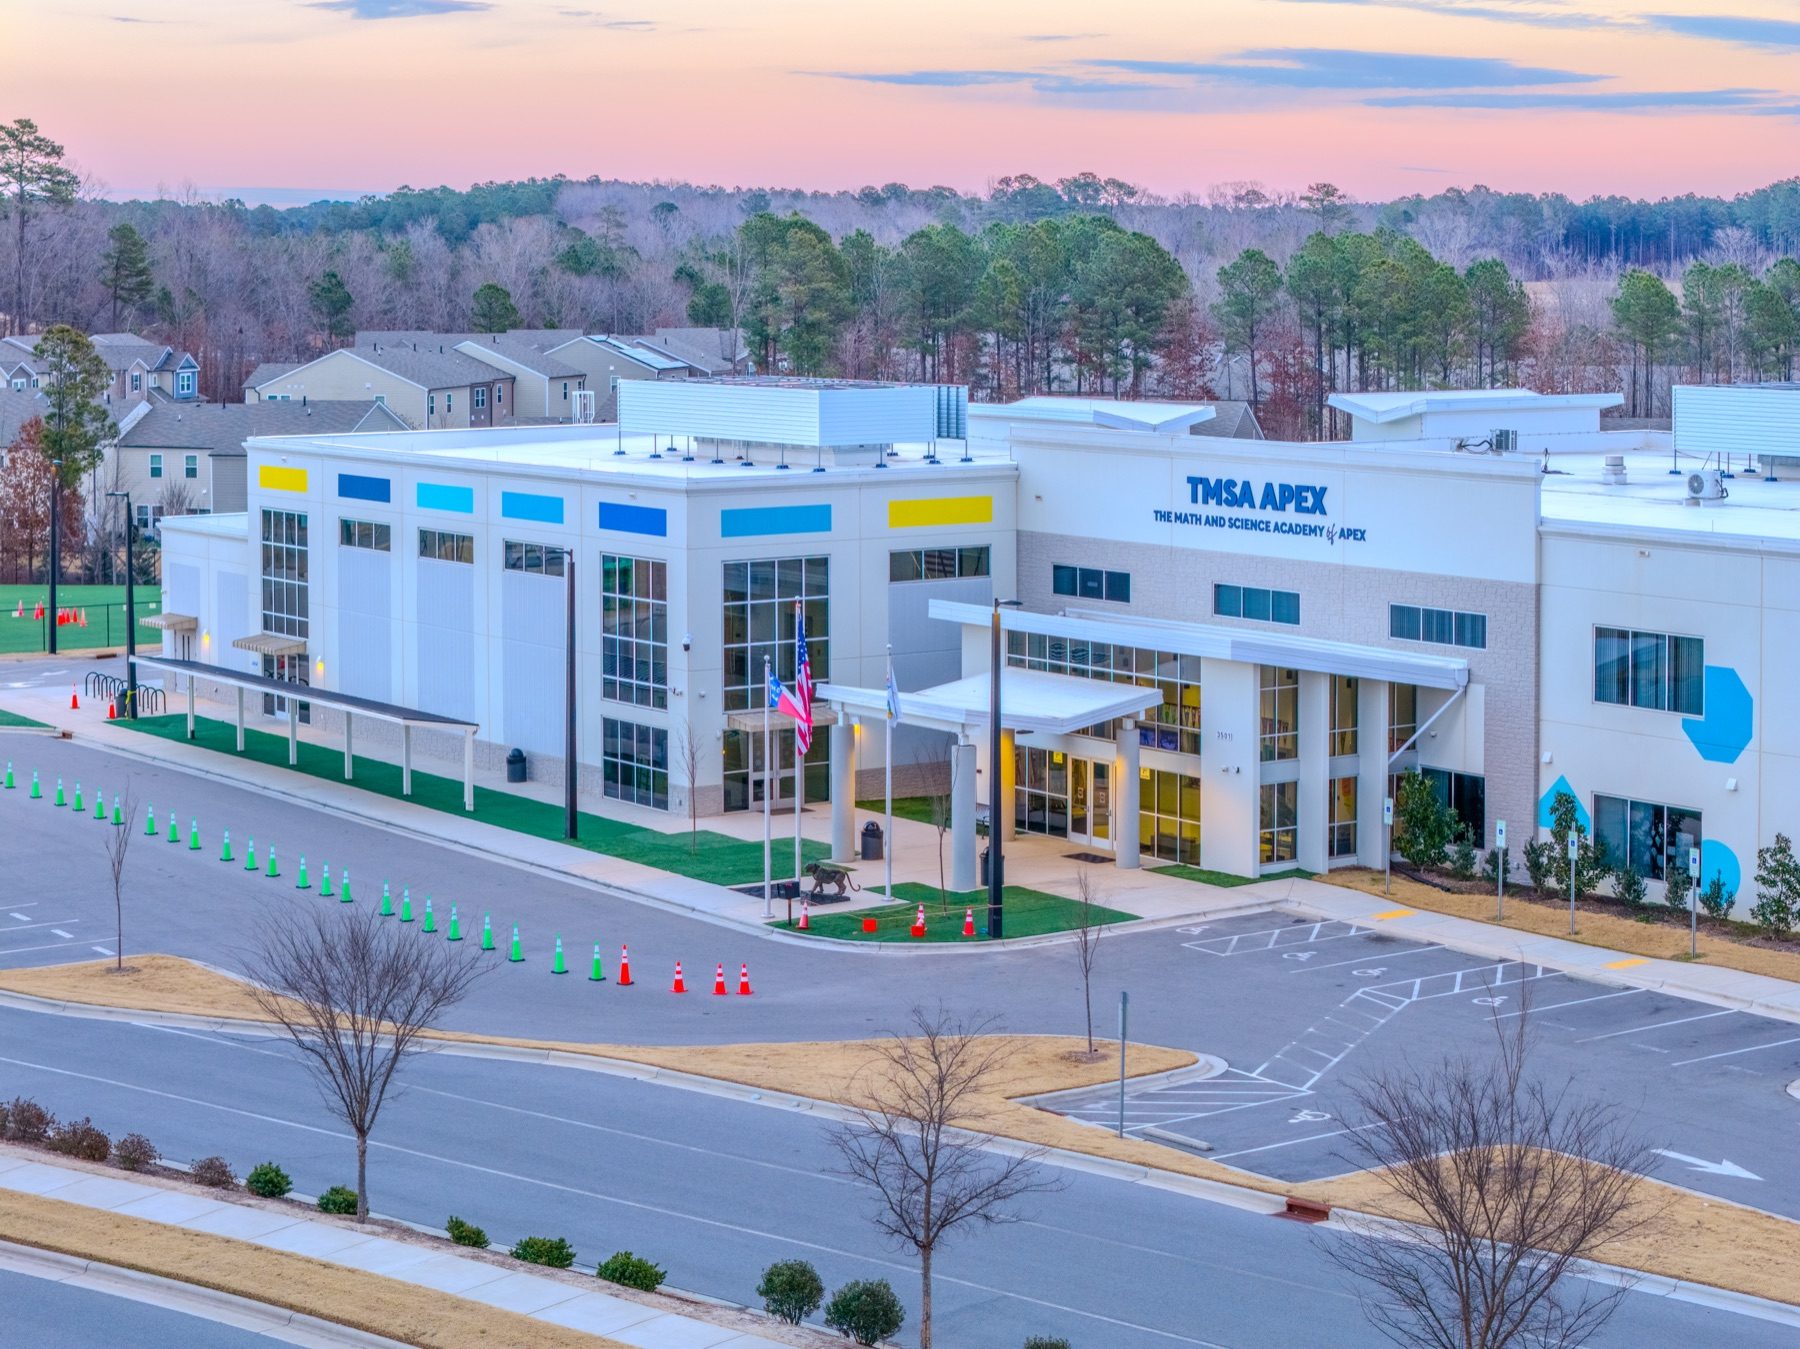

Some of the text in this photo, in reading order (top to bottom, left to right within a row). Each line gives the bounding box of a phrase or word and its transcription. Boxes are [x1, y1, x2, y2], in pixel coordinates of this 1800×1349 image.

[1187, 476, 1328, 516] TMSA APEX
[1153, 510, 1367, 546] THE MATH AND SCIENCE ACADEMY of APEX
